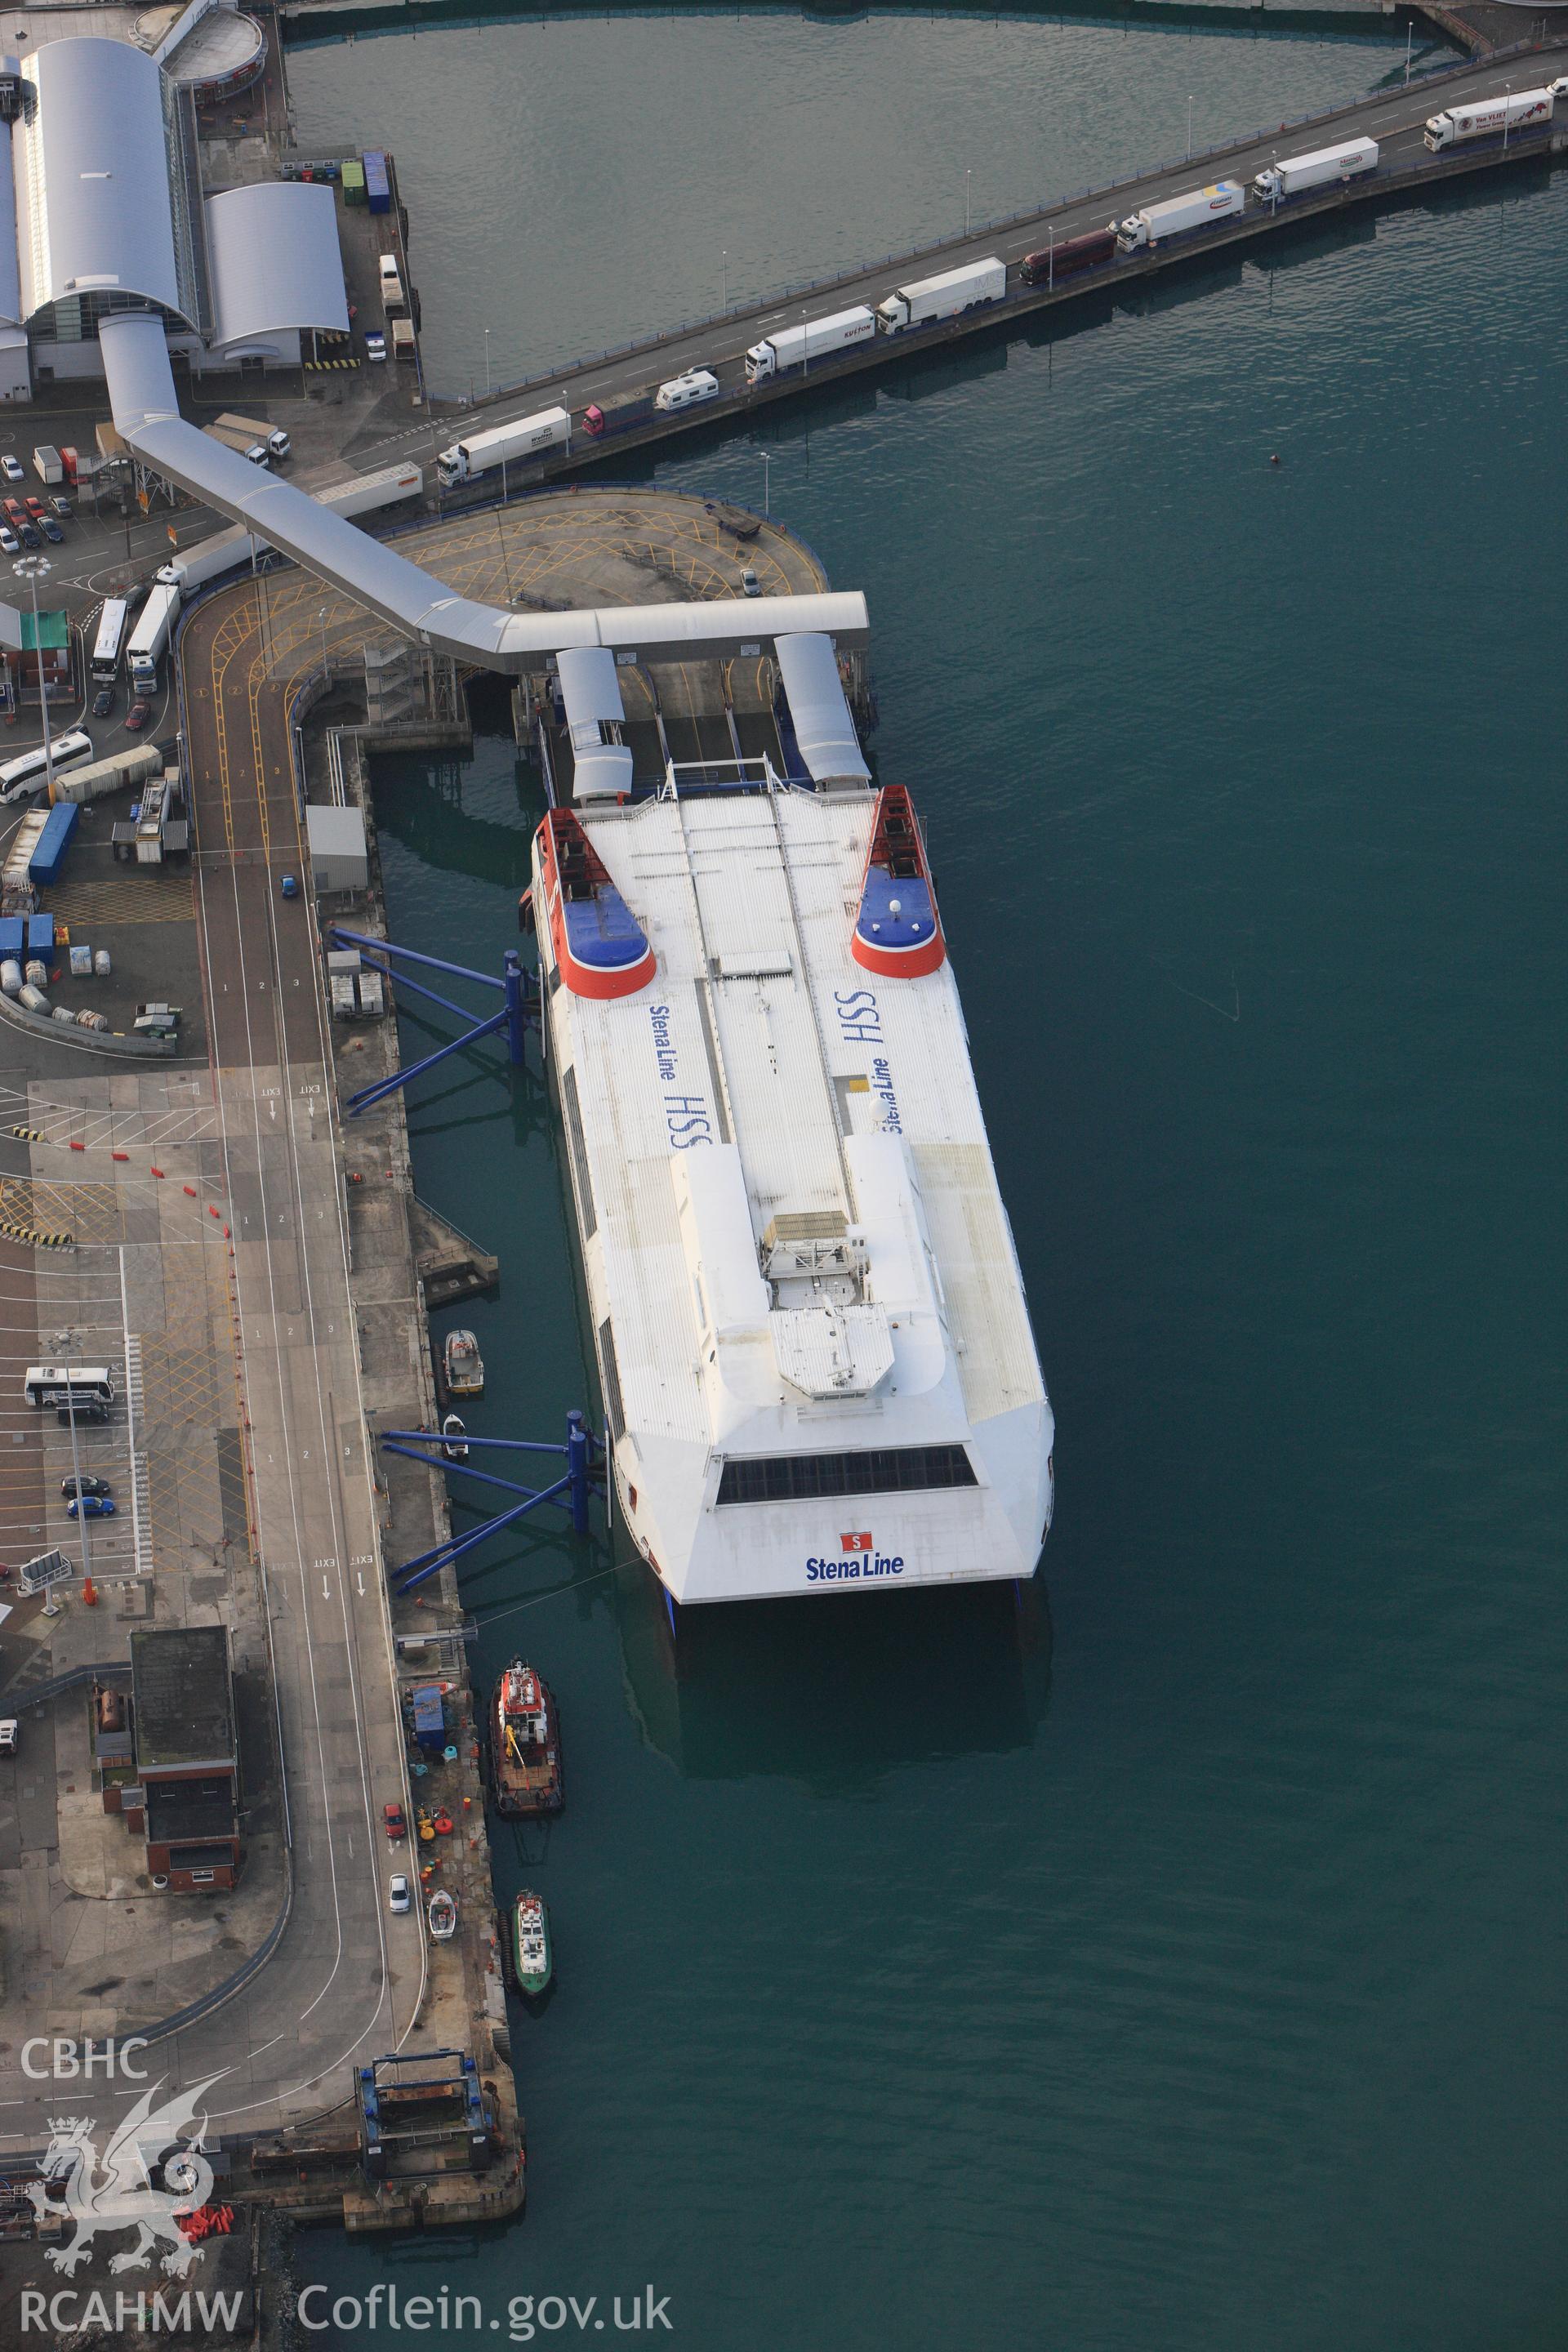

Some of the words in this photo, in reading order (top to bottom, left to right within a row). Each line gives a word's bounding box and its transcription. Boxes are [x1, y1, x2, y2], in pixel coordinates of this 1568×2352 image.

[1476, 116, 1487, 124] Van
[1488, 111, 1507, 121] VLIET
[224, 983, 229, 991] 1
[835, 991, 884, 1044] HSS
[649, 1005, 670, 1048] Stena
[657, 1049, 679, 1080] Line
[873, 1058, 893, 1090] Line
[261, 1087, 281, 1097] EXIT
[299, 1085, 320, 1094] EXIT
[664, 1096, 714, 1150] HSS
[278, 1214, 284, 1223] 2
[318, 1211, 323, 1219] 3
[244, 1216, 249, 1224] 1
[287, 1327, 294, 1335] 2
[327, 1325, 334, 1333] 3
[256, 1330, 261, 1338] 1
[303, 1450, 309, 1459] 2
[344, 1446, 350, 1455] 3
[268, 1454, 274, 1463] 1
[852, 1535, 862, 1549] S
[313, 1558, 336, 1567] EXIT
[350, 1555, 373, 1566] EXIT
[806, 1557, 860, 1580] Stena
[863, 1552, 904, 1576] Line
